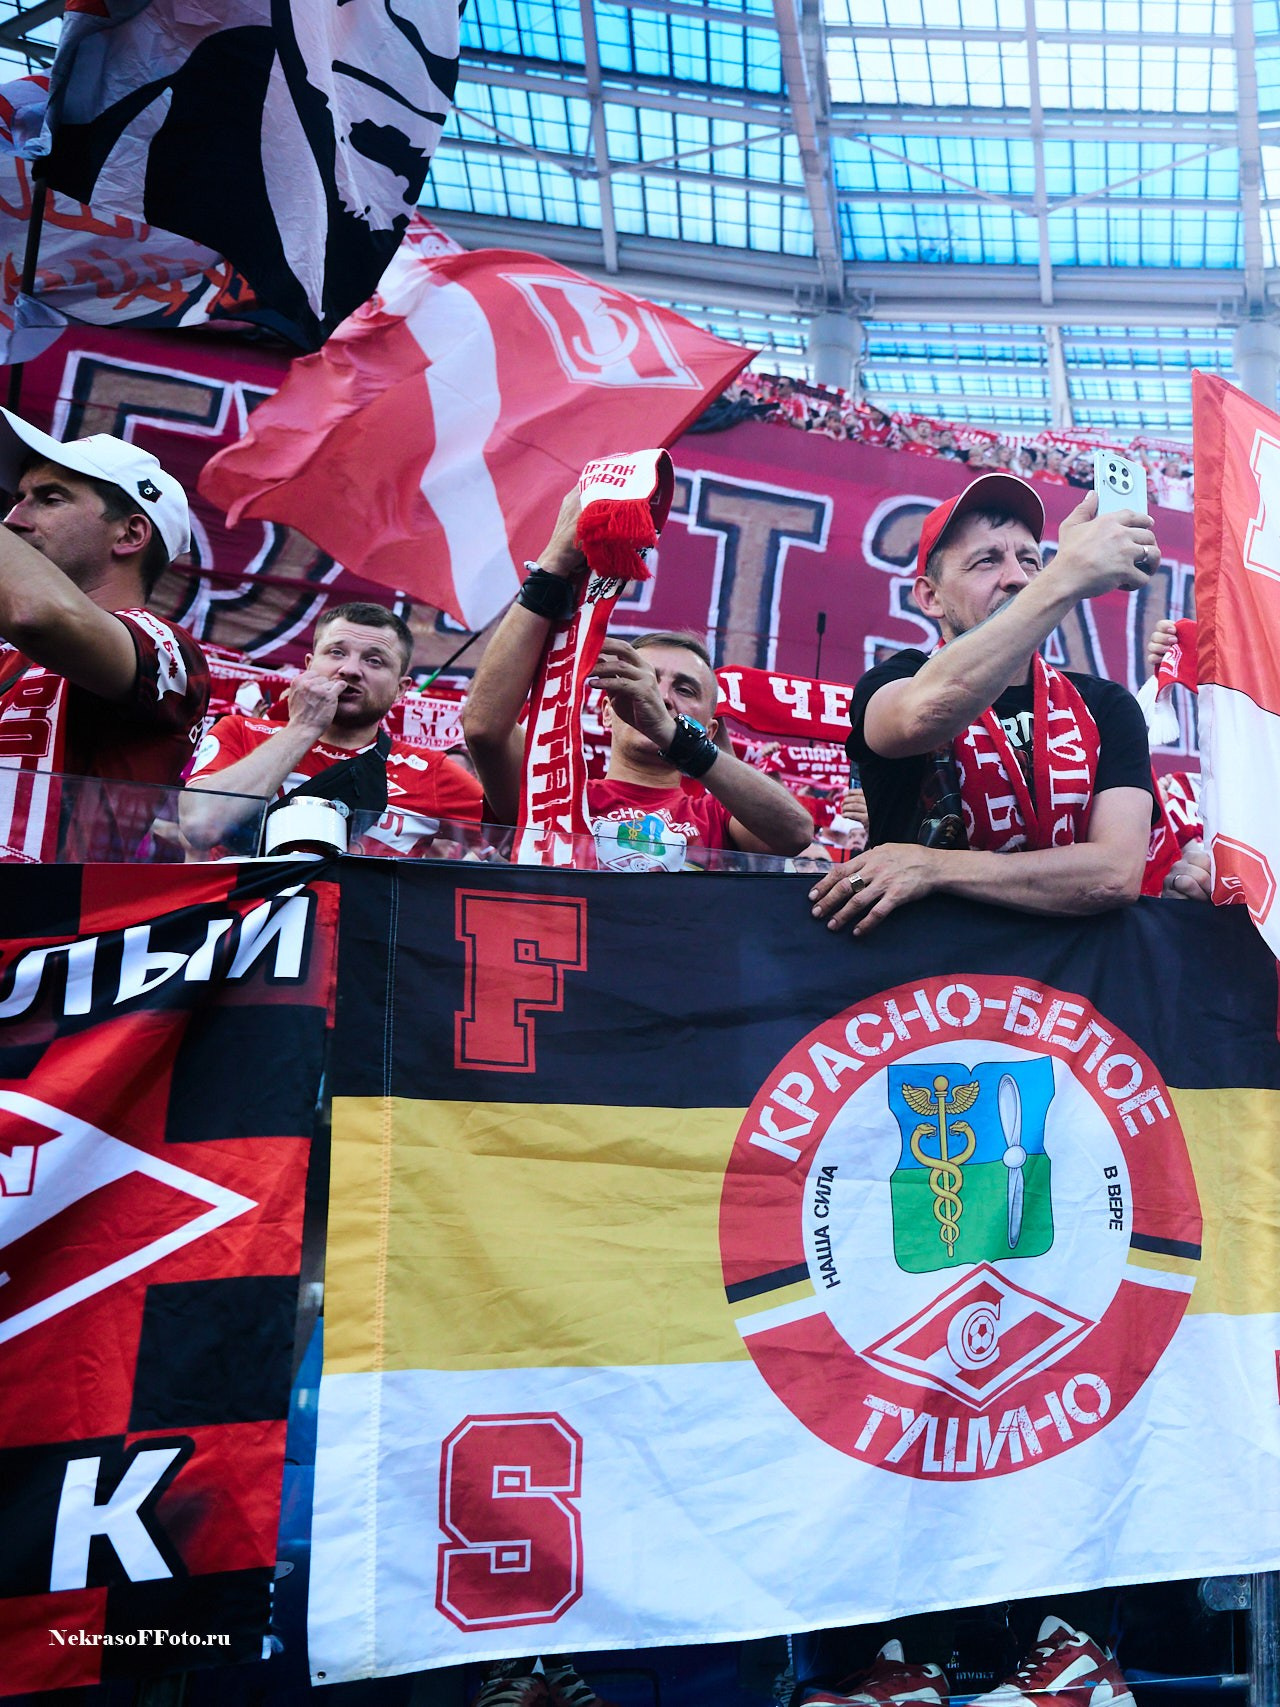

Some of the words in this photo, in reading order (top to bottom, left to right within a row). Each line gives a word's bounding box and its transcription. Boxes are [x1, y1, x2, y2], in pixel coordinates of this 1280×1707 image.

[580, 474, 627, 493] СКВА
[584, 464, 636, 475] РТАК
[718, 671, 747, 713] Ы
[0, 885, 311, 1019] ЛЫЙ
[748, 983, 1171, 1162] КРАСНО-БЕЛОЕ
[813, 1164, 839, 1220] СИЛА
[1106, 1183, 1124, 1232] ВЕРЕ
[814, 1224, 842, 1289] НАША
[854, 1372, 1112, 1474] ТУШИНО
